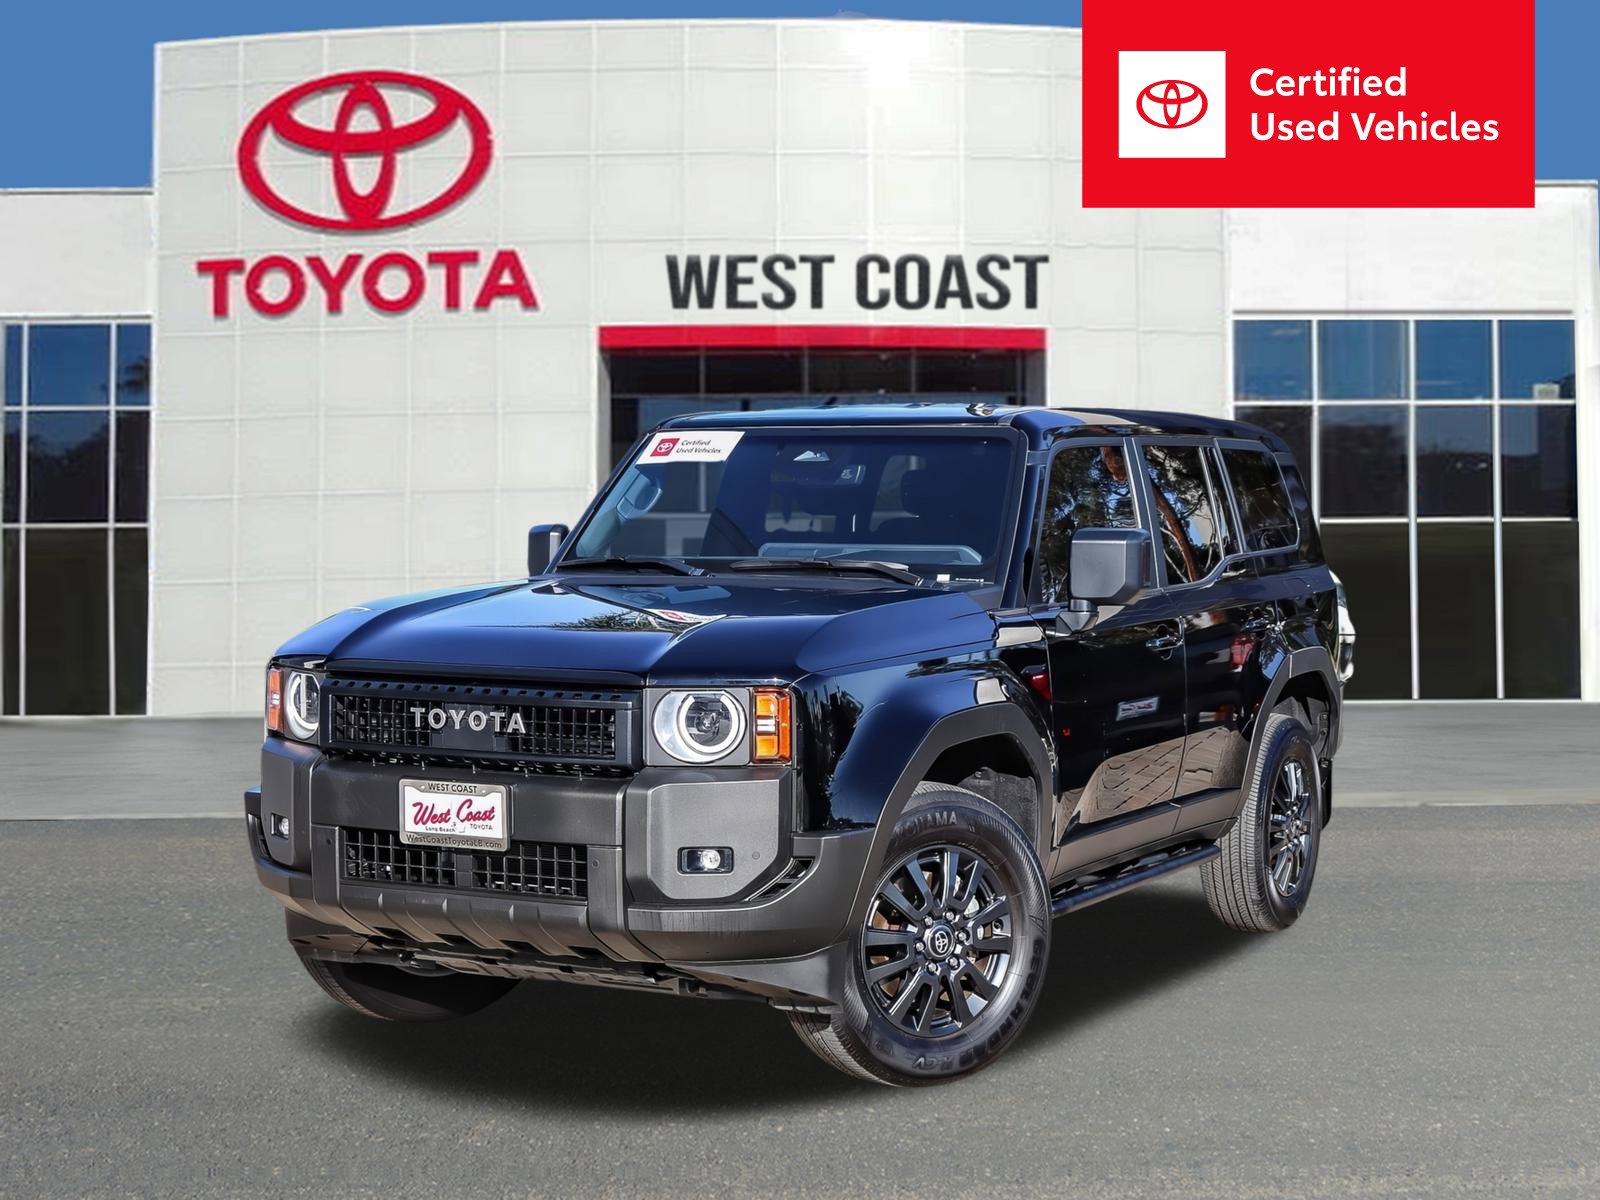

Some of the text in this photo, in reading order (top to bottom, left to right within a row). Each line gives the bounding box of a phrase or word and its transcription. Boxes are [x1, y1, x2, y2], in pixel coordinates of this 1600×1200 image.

[196, 249, 540, 318] TOYOTA
[665, 253, 1049, 310] WEST COAST
[675, 447, 722, 455] Used Vehicles
[680, 439, 712, 447] Certified
[410, 706, 527, 734] TOYOTA
[427, 782, 478, 794] WEST COAST
[412, 798, 495, 826] West Coast
[470, 823, 493, 831] TOYOTA
